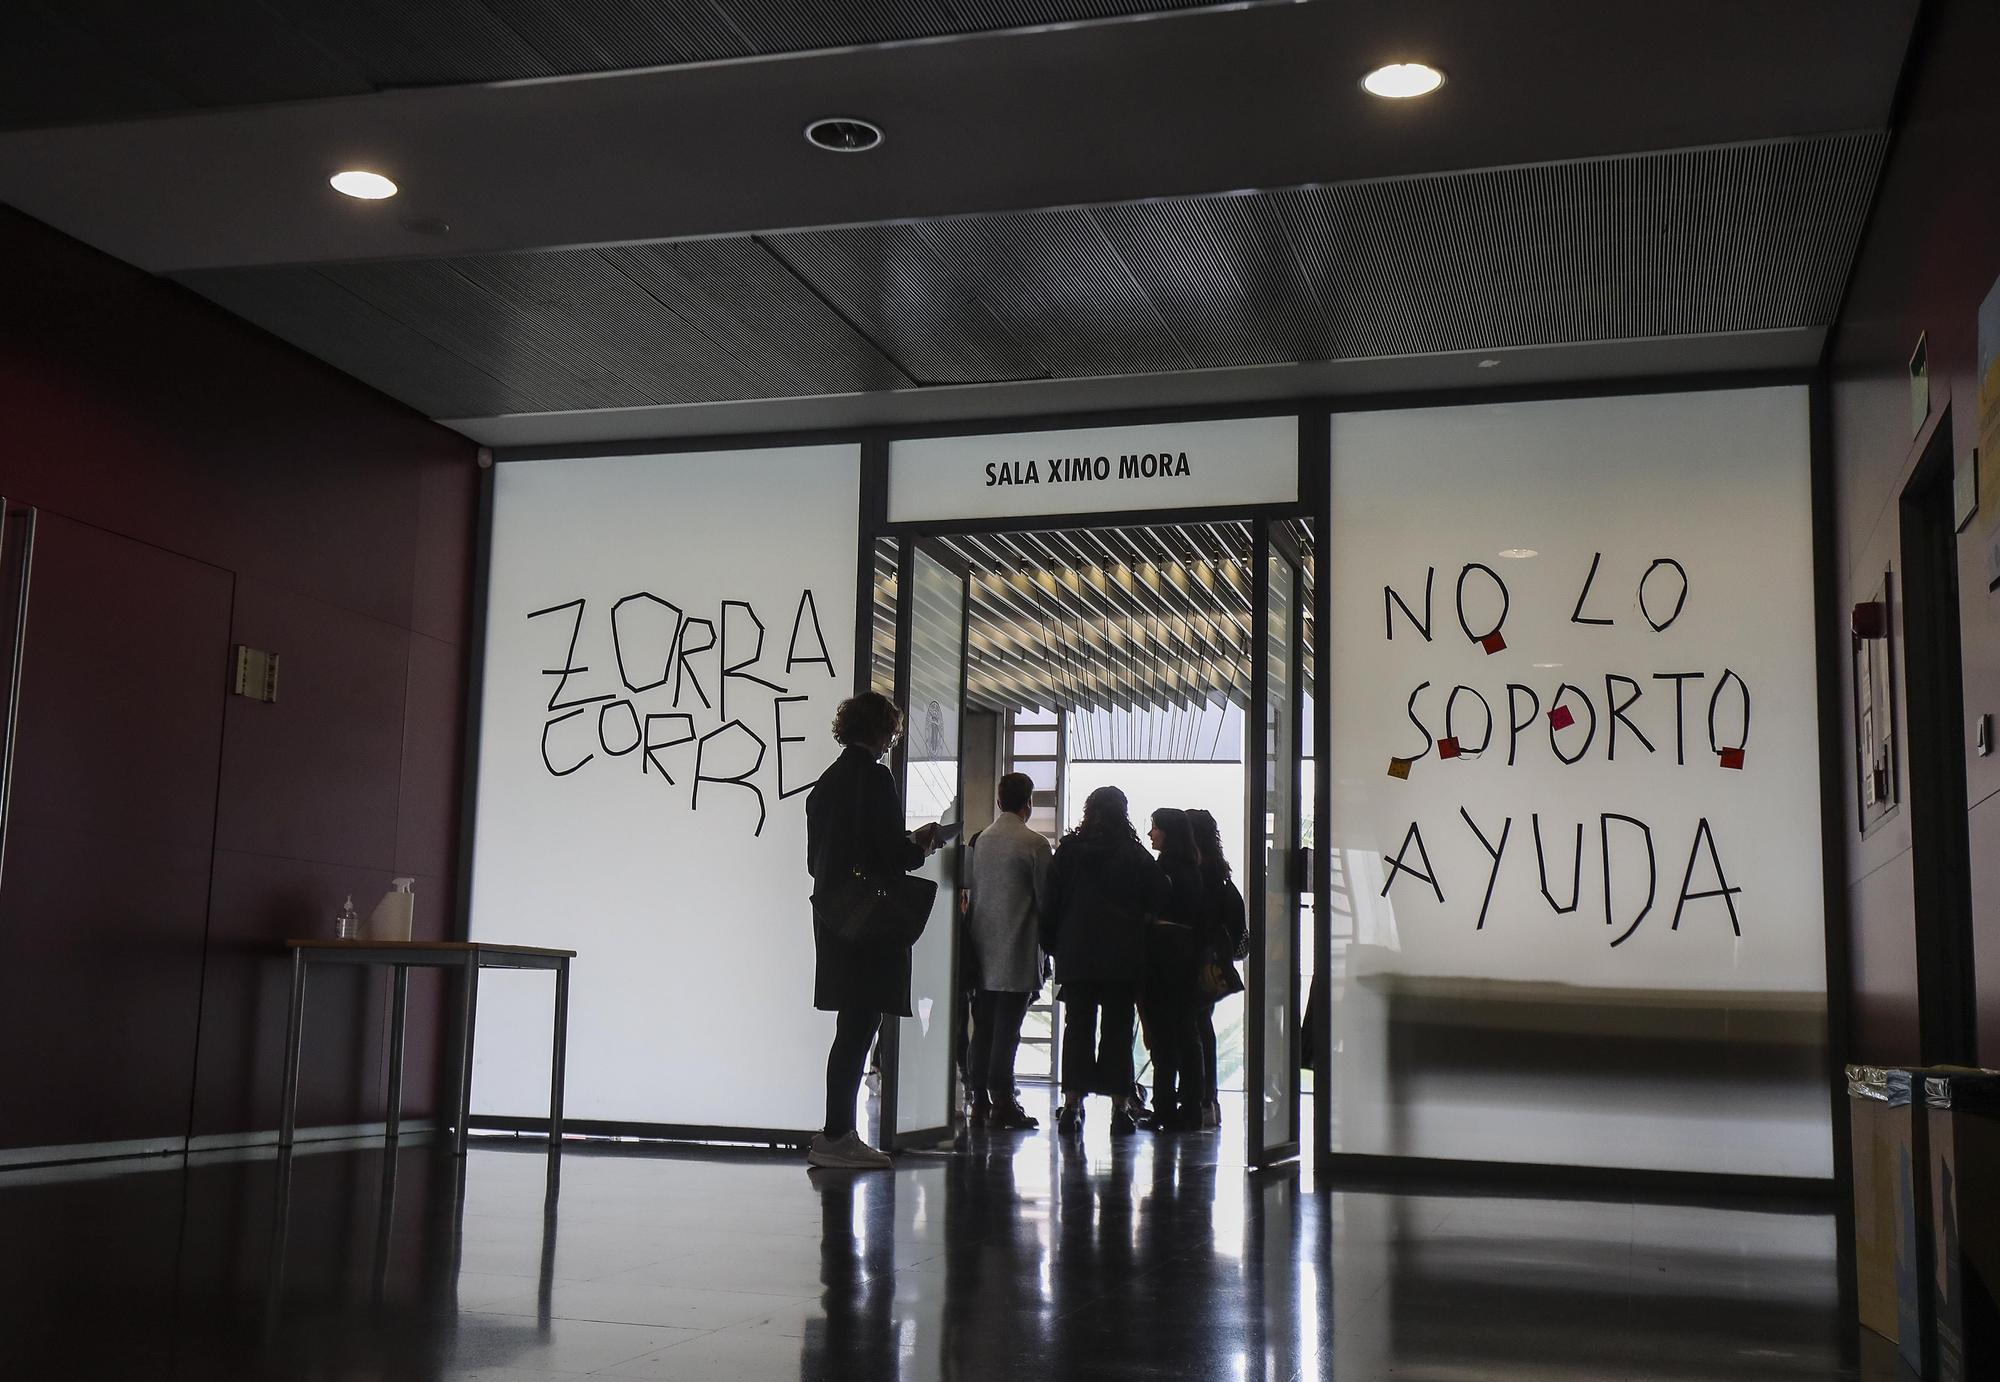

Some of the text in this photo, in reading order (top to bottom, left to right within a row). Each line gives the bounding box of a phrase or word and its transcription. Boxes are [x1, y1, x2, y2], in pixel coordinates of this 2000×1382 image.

[985, 452, 1191, 487] SALA XIMO MORA
[527, 589, 836, 723] ZORRA
[1384, 551, 1688, 646] NO LO
[541, 695, 818, 838] CORRE
[1390, 668, 1751, 771] SOPORTO
[1381, 806, 1743, 948] AYUDA
